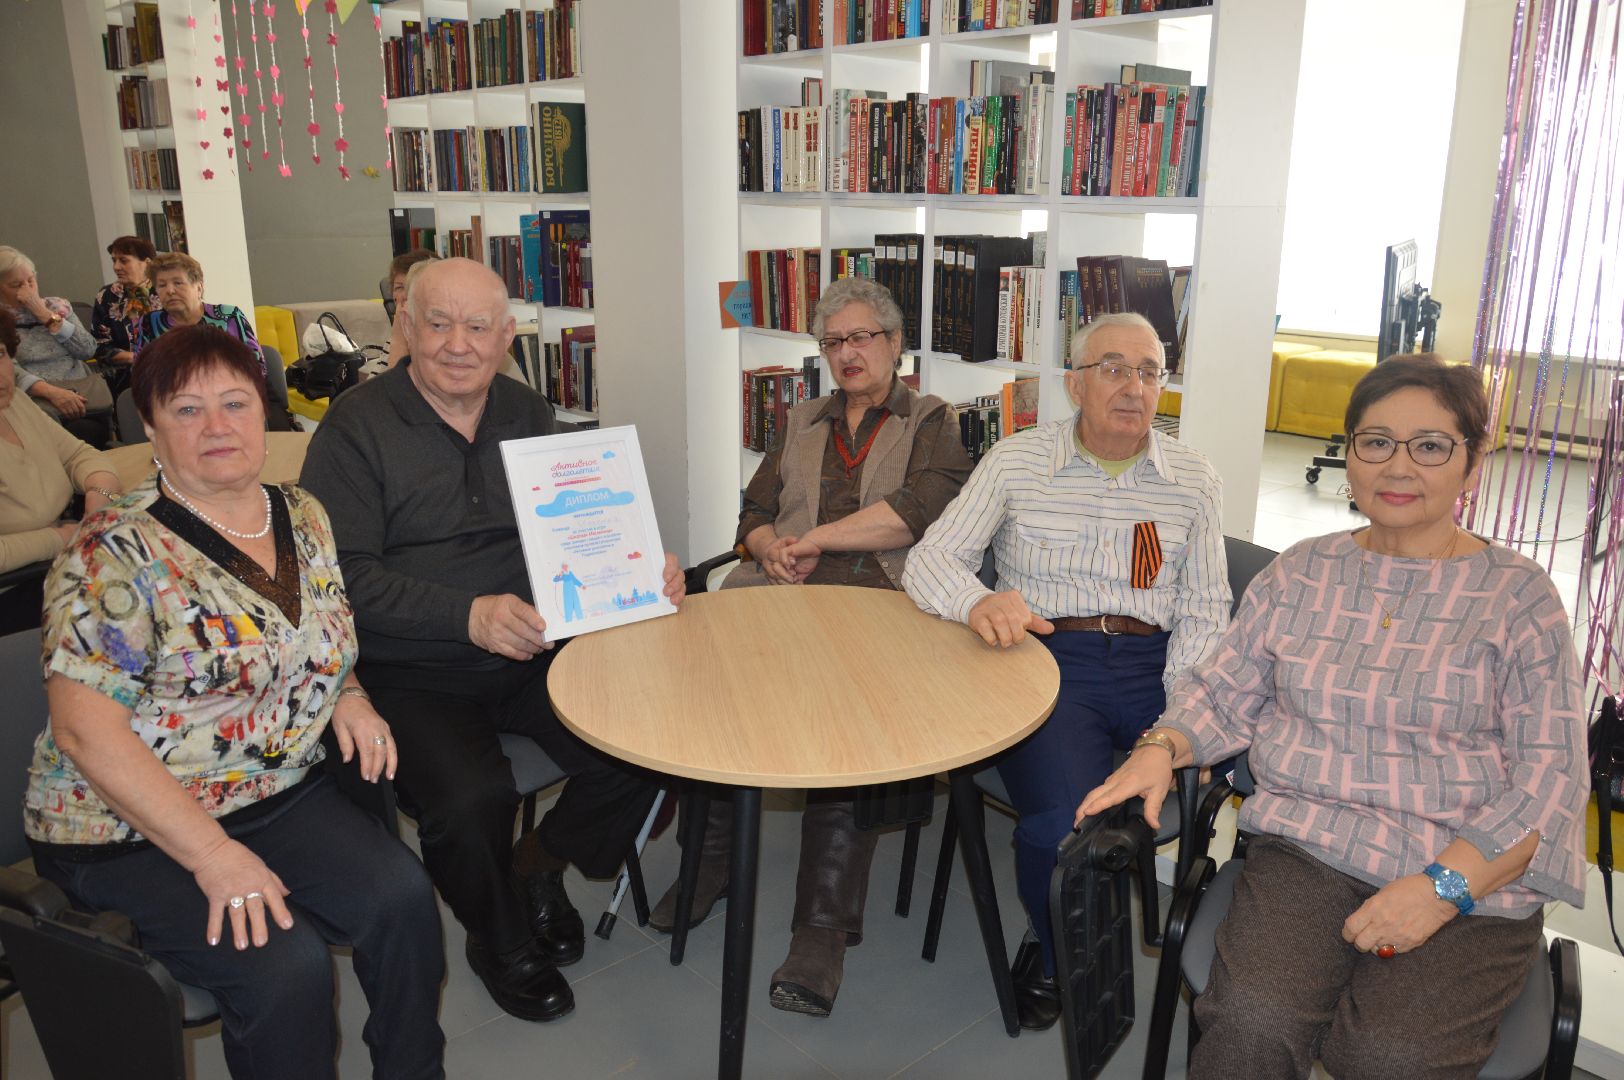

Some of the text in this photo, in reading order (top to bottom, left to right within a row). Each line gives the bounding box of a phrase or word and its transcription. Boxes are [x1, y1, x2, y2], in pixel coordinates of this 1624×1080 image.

[555, 118, 563, 140] 1812
[543, 106, 554, 186] БОРОДИНО
[968, 127, 979, 180] ЛЕНИН
[550, 459, 598, 472] Активное
[565, 491, 609, 507] ДИПЛОМ
